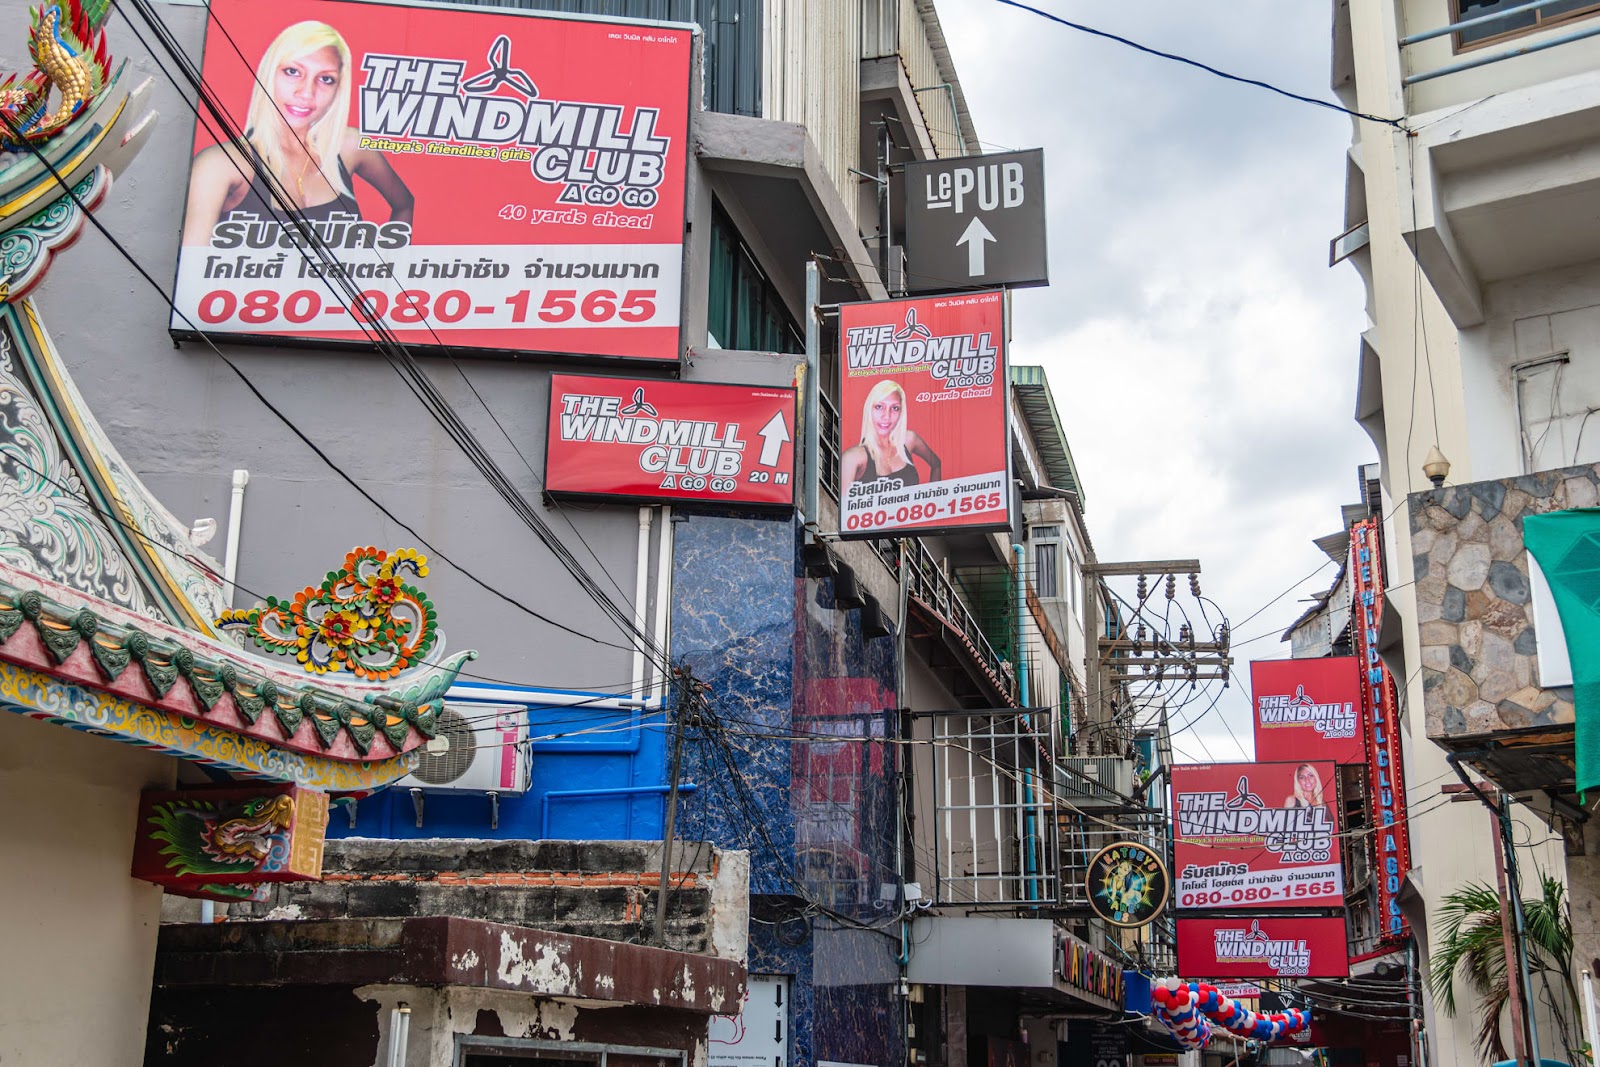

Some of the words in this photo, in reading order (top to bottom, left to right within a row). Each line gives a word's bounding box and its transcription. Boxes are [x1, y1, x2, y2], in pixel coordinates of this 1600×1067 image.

[359, 52, 464, 96] THE
[359, 87, 671, 155] WINDMILL
[359, 137, 423, 154] Pattaya's
[426, 141, 496, 160] friendliest
[498, 145, 532, 162] girls
[531, 144, 665, 188] CLUB
[558, 182, 582, 203] A
[584, 184, 620, 207] GO
[621, 187, 659, 209] GO
[500, 205, 527, 221] 40
[531, 208, 586, 228] yards
[591, 211, 653, 230] ahead
[209, 211, 413, 250] รับสมัคร
[204, 251, 285, 280] โคโยตี้
[407, 257, 509, 280] ม่าม่าซัง
[524, 257, 659, 280] จำนวนมาก
[197, 289, 658, 325] 080-080-1565
[846, 325, 895, 347] THE
[846, 332, 998, 368] WINDMILL
[931, 356, 995, 379] CLUB
[945, 377, 956, 388] A
[956, 375, 974, 388] GO
[974, 373, 993, 386] GO
[561, 394, 622, 416] THE
[916, 392, 931, 403] 40
[931, 391, 961, 404] yards
[961, 387, 992, 399] ahead
[560, 413, 746, 450] WINDMILL
[639, 445, 742, 477] CLUB
[660, 474, 676, 489] A
[680, 476, 706, 491] GO
[710, 477, 737, 493] GO
[749, 470, 769, 483] 20
[774, 473, 789, 484] M
[848, 477, 904, 499] รับสมัคร
[953, 480, 1001, 496] จำนวนมาก
[846, 492, 1001, 531] 080-080-1565
[1356, 527, 1374, 582] THE
[1359, 588, 1386, 744] WINDMILL
[1258, 695, 1290, 708] THE
[1259, 702, 1357, 723] WINDMILL
[1314, 719, 1356, 732] CLUB
[1332, 730, 1343, 738] GO
[1343, 730, 1355, 738] GO
[1375, 749, 1395, 827] CLUB
[1177, 792, 1226, 811] THE
[1177, 806, 1335, 836] WINDMILL
[1265, 832, 1331, 853] CLUB
[1381, 834, 1398, 851] A
[1103, 848, 1158, 872] KATOEYS
[1280, 851, 1293, 863] A
[1293, 850, 1311, 863] GO
[1311, 849, 1331, 862] GO
[1181, 862, 1249, 880] รับสมัคร
[1181, 881, 1337, 907] 080-080-1565
[1114, 911, 1130, 922] US
[1214, 929, 1245, 941] THE
[1214, 940, 1310, 957] WINDMILL
[1268, 955, 1310, 969] CLUB
